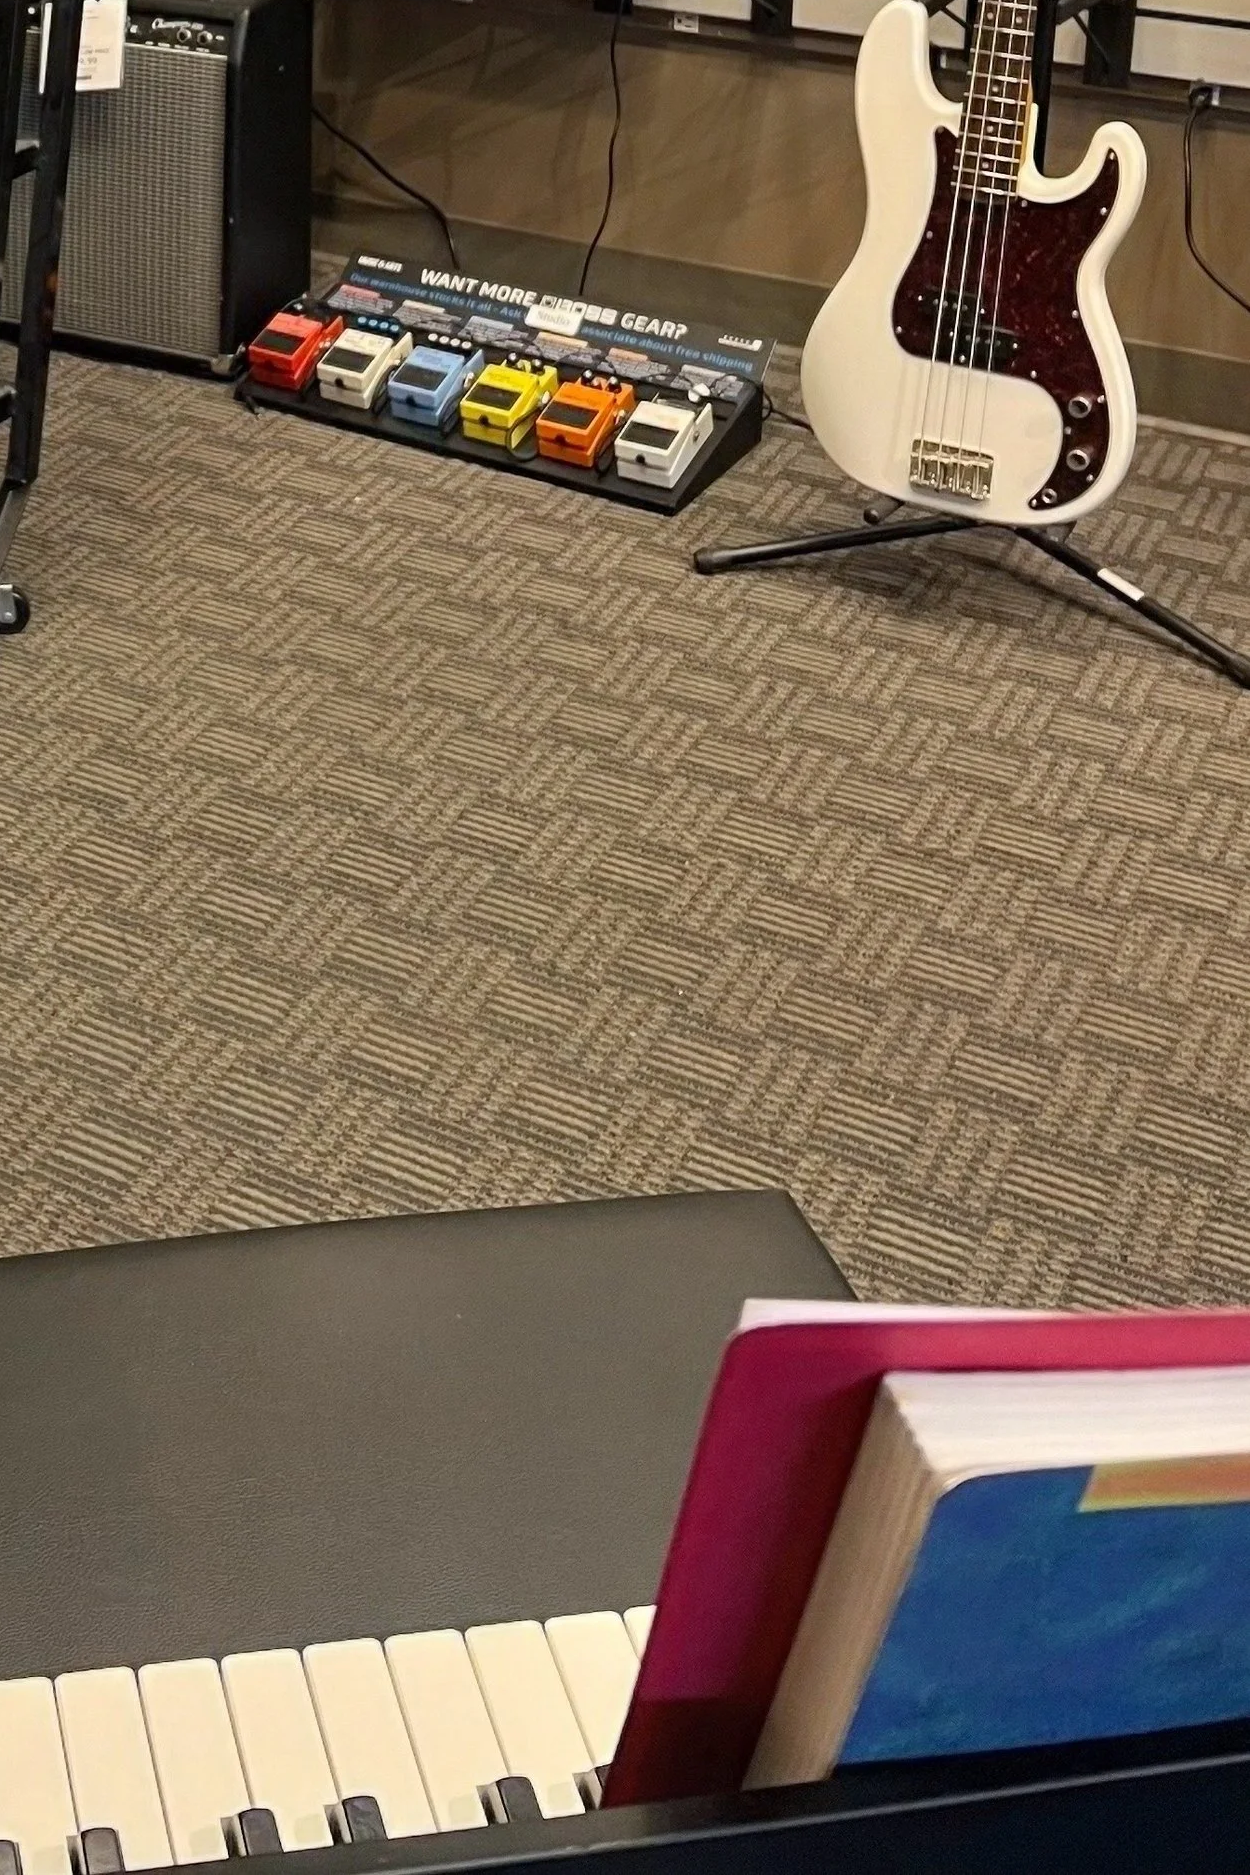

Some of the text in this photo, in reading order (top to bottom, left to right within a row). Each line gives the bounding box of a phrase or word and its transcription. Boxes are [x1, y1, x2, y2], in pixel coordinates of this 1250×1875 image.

[371, 277, 426, 298] warehouse
[429, 289, 465, 308] stocks
[581, 326, 637, 344] associate
[638, 337, 674, 354] about
[675, 344, 701, 360] free
[702, 350, 753, 372] shipping
[421, 269, 479, 293] WANT
[479, 281, 537, 307] MORE
[621, 312, 688, 340] GEAR?
